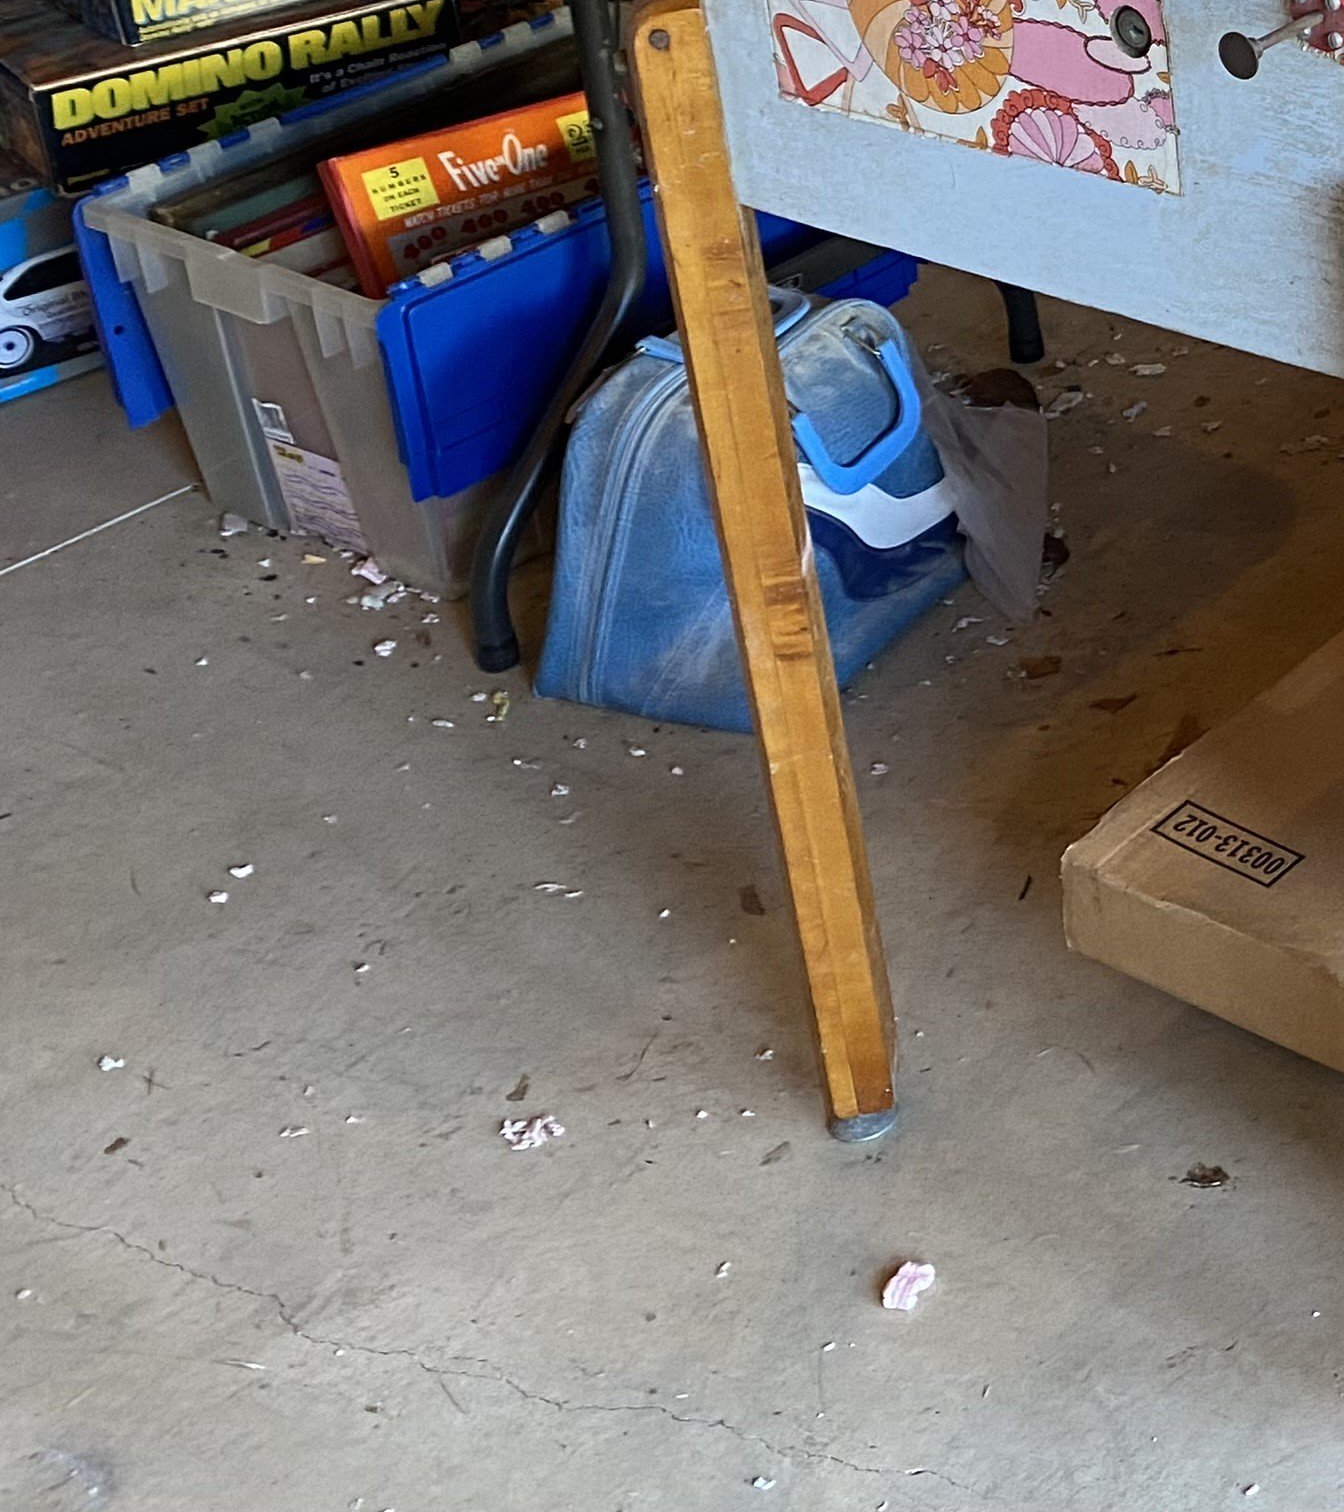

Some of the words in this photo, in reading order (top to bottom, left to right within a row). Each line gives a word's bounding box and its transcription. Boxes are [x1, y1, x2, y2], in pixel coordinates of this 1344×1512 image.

[51, 40, 284, 130] DOMINO
[61, 106, 174, 147] ADVENTURE
[175, 97, 209, 122] SET
[389, 167, 400, 179] 5
[1172, 813, 1287, 876] 00313-012
